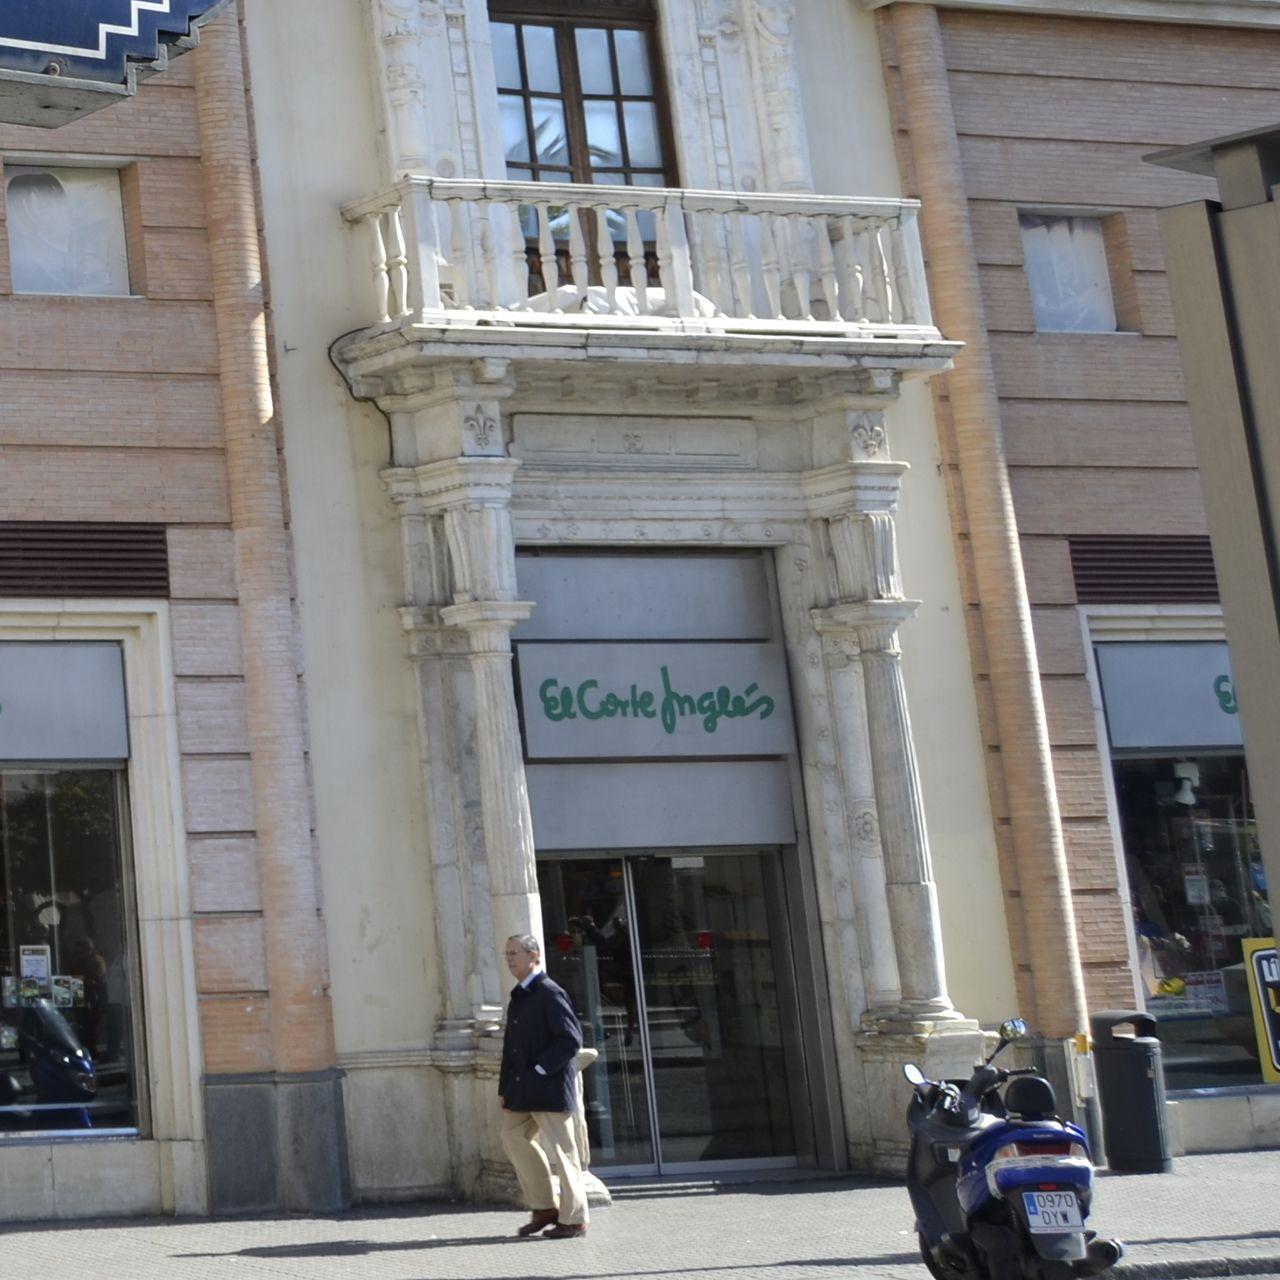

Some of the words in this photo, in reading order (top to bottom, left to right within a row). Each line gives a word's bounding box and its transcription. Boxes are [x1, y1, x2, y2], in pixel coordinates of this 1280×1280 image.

[540, 678, 576, 720] El
[577, 679, 655, 720] Corte
[660, 665, 774, 733] Inglés
[1037, 1193, 1074, 1208] 0970
[1041, 1210, 1070, 1226] DY
